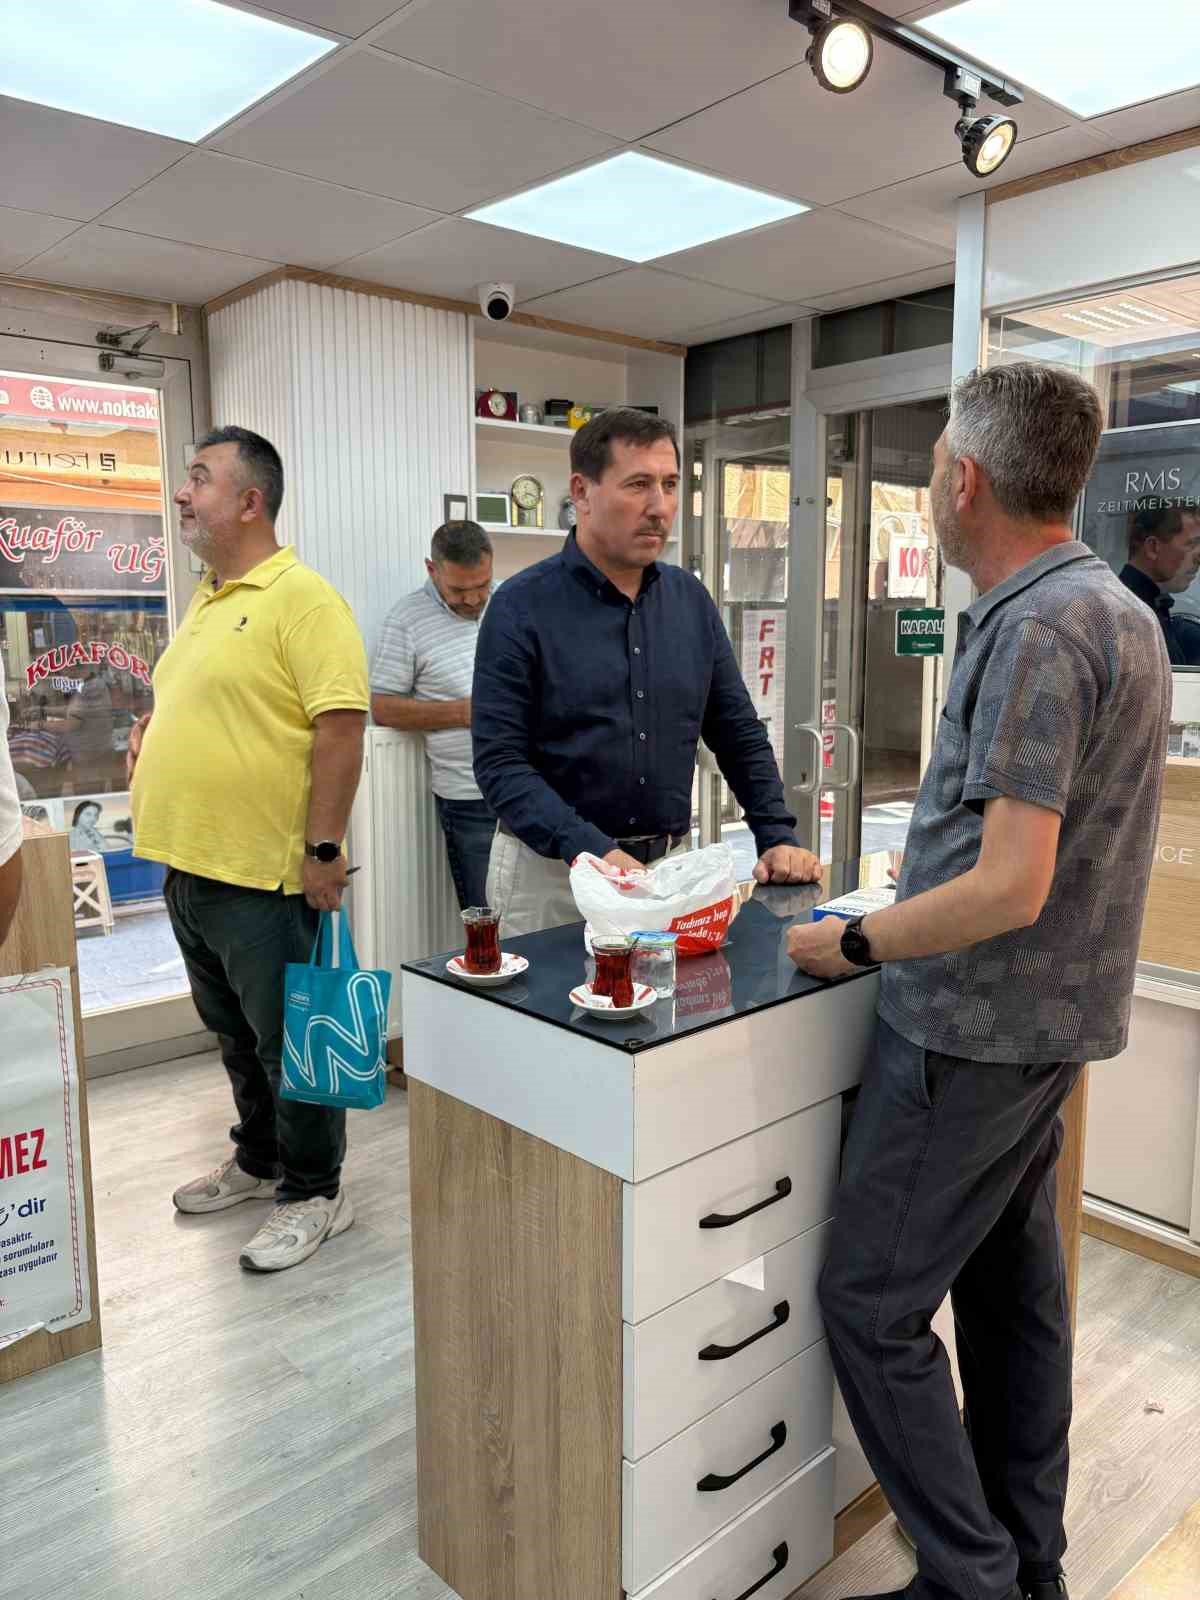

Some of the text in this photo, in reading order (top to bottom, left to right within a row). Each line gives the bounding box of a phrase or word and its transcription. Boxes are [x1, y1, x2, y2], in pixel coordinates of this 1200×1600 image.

[1125, 467, 1181, 494] RMS
[25, 640, 153, 689] KUAFÖR
[0, 1231, 33, 1249] asaktır.
